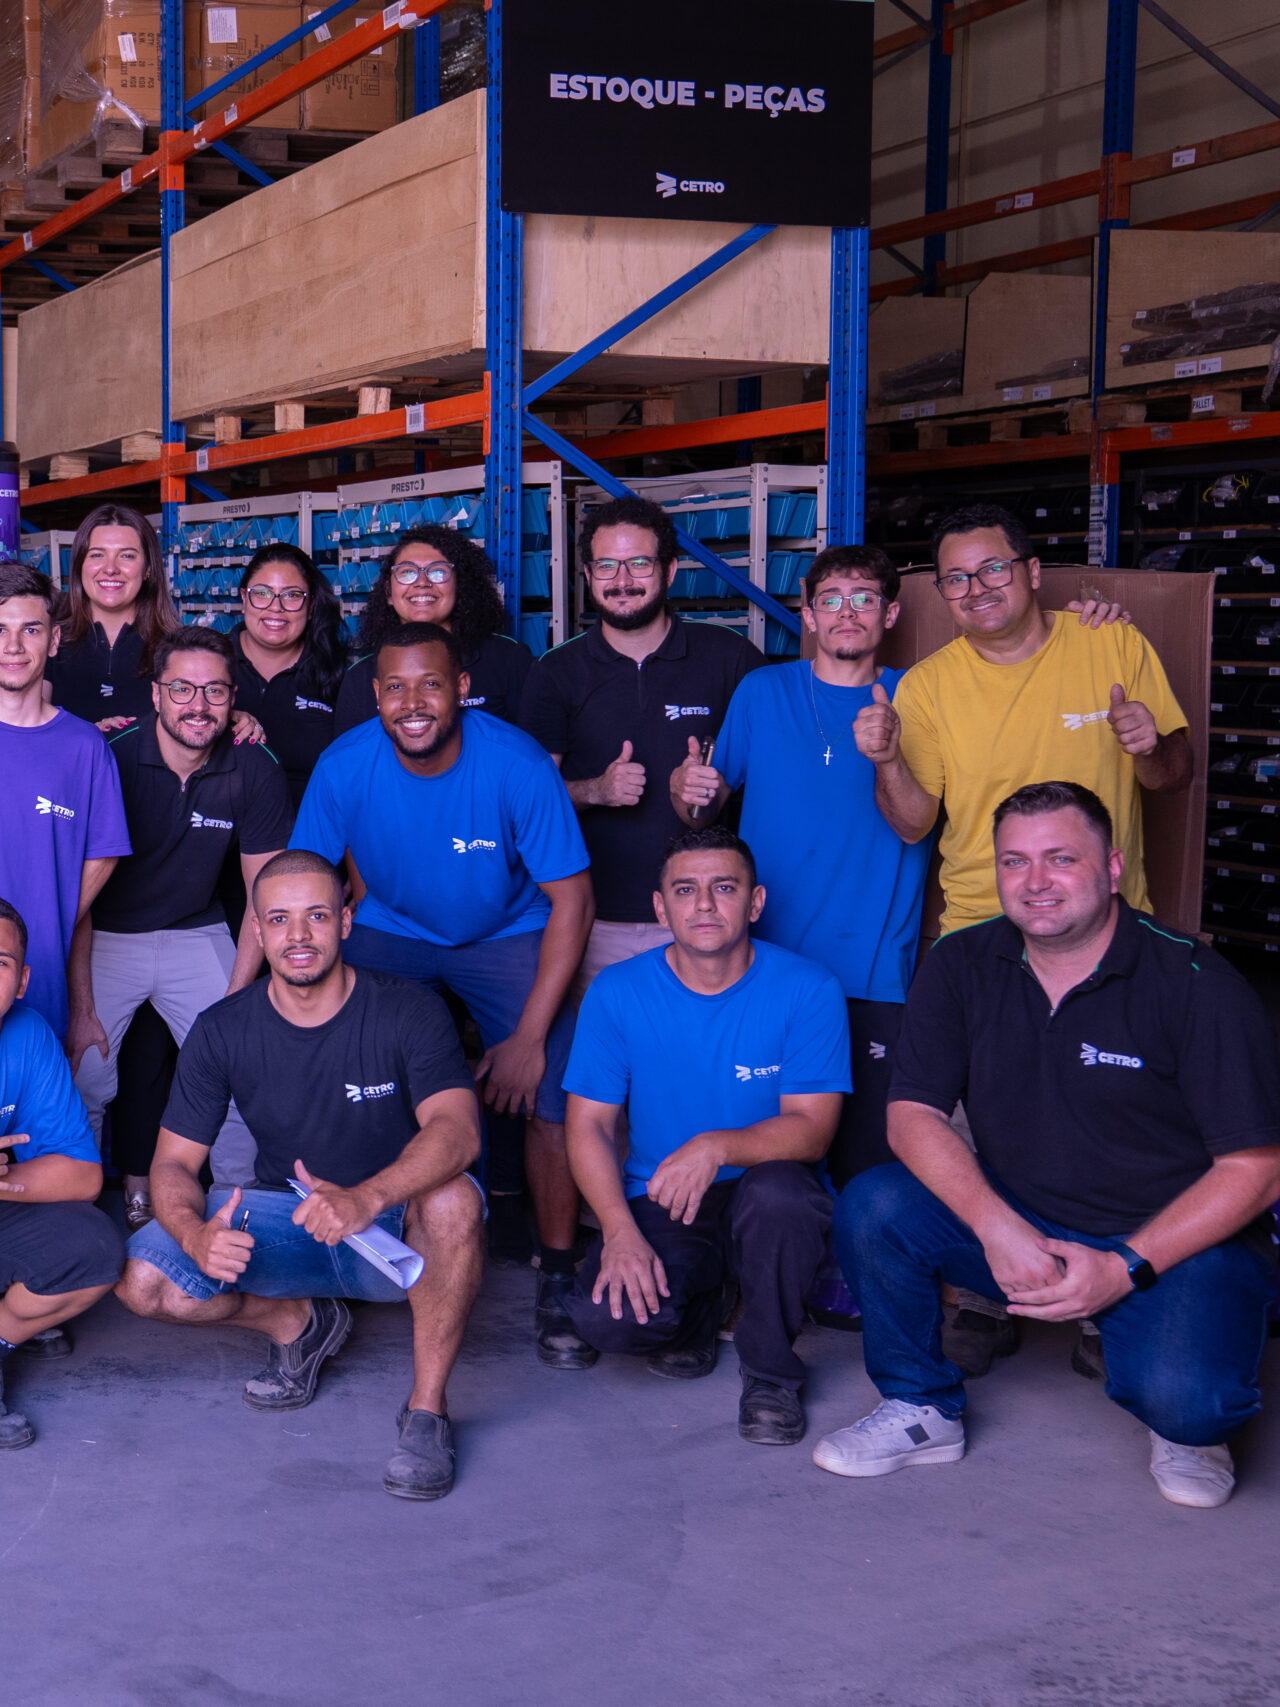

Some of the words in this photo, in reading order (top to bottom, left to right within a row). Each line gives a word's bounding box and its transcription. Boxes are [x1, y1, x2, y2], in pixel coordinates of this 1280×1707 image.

[549, 72, 696, 109] ESTOQUE
[724, 83, 826, 118] PEÇAS
[679, 180, 725, 193] CETRO
[391, 480, 420, 494] PRESTO
[680, 706, 711, 716] CETRO
[1083, 710, 1109, 722] CETR
[51, 803, 75, 818] CETRO
[203, 818, 233, 829] CETRO
[467, 839, 496, 849] CETRO
[1098, 1051, 1142, 1068] CETRO
[753, 1063, 781, 1076] CETR
[363, 1082, 395, 1096] CETRO
